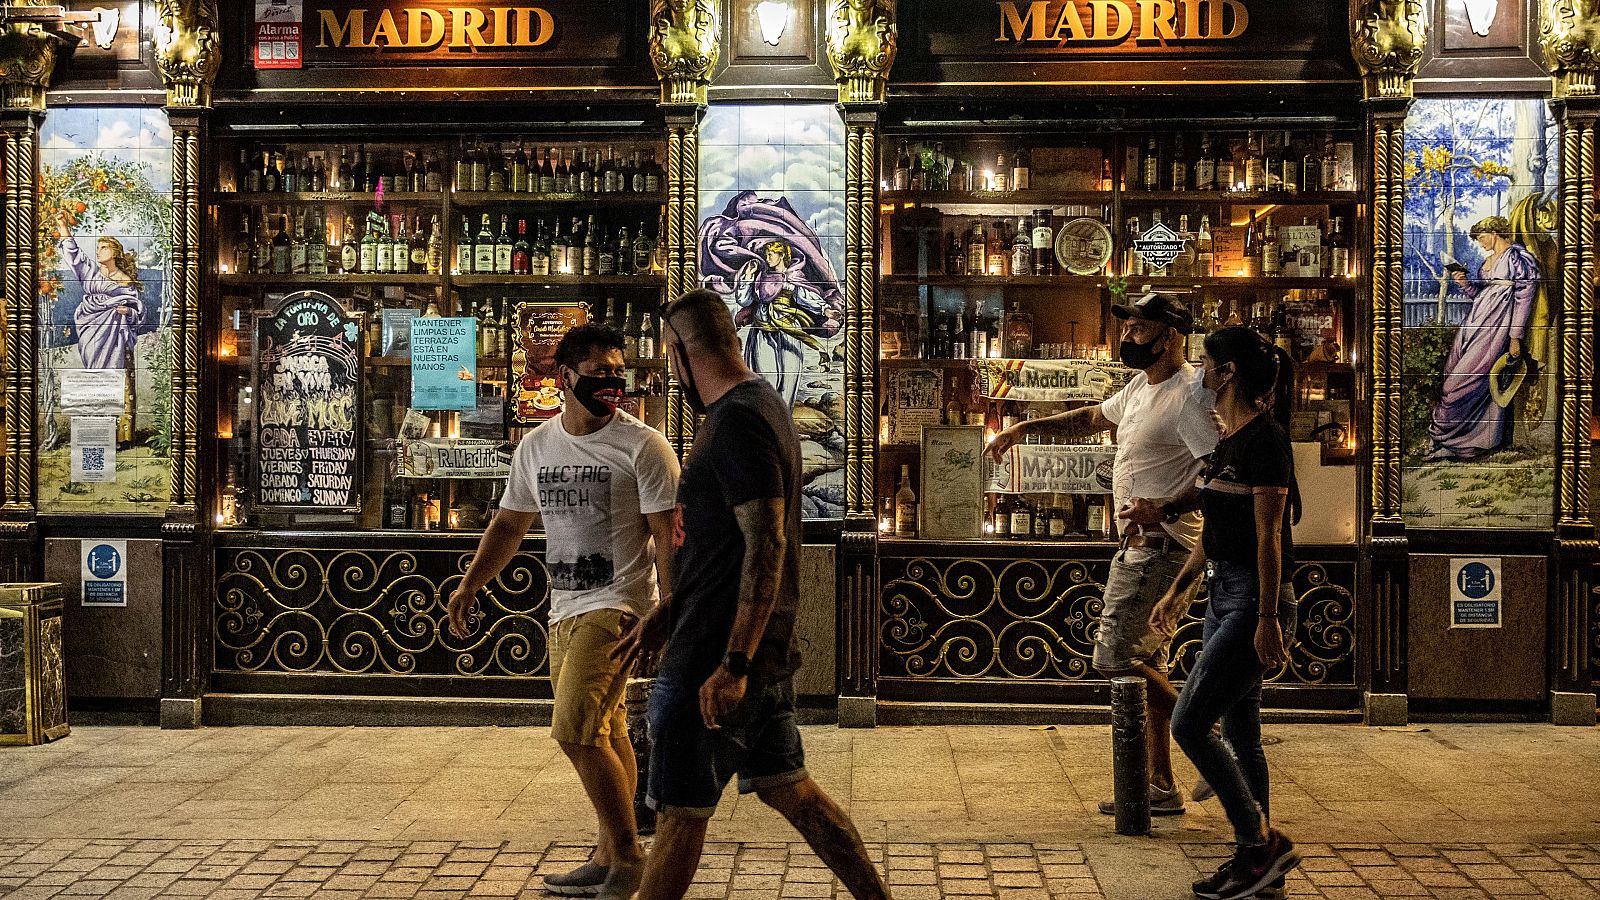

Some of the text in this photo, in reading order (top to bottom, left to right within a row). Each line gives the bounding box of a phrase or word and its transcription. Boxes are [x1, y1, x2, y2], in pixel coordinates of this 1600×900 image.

[259, 24, 299, 35] Alarma
[315, 7, 555, 48] MADRID
[994, 0, 1249, 42] MADRID
[1280, 231, 1316, 240] CELTAS
[275, 318, 287, 331] LA
[326, 313, 340, 327] DE
[297, 312, 319, 326] ORO
[413, 319, 462, 327] MANTENER
[413, 328, 466, 336] LIMPIAS LAS
[413, 337, 459, 345] TERRAZAS
[413, 344, 449, 353] ESTÁ EN
[413, 354, 459, 362] NUESTRAS
[413, 363, 445, 371] MANOS
[1026, 369, 1079, 388] Madrid
[261, 428, 354, 448] CADA EVERY
[261, 447, 355, 461] JUEVES THURSDAY
[455, 447, 499, 468] Madrid
[539, 465, 610, 484] ELECTRIC
[1023, 456, 1096, 478] MADRID
[261, 473, 352, 490] SABADO SATURDAY
[313, 488, 349, 505] SUNDAY
[539, 488, 590, 507] BEACH
